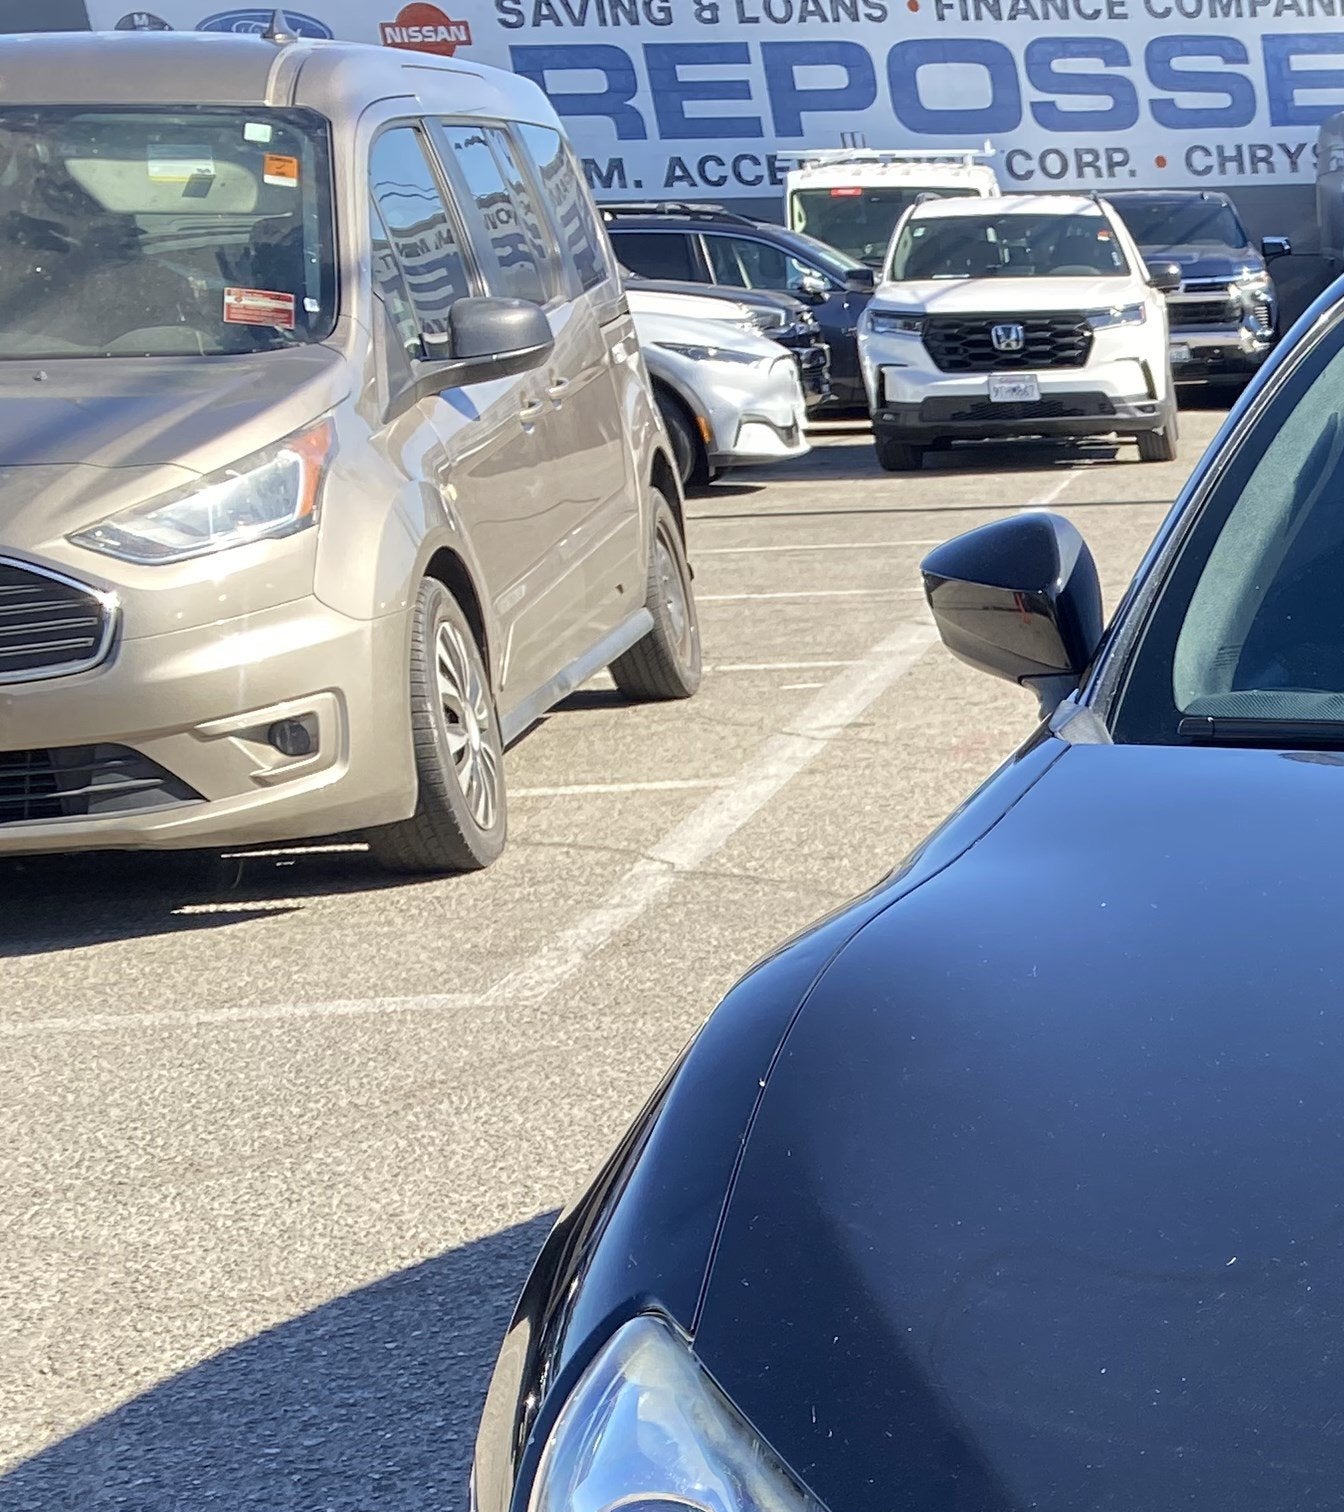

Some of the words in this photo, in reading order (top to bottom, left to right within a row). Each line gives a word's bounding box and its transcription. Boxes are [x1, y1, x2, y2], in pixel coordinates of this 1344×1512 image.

[498, 0, 674, 29] SAVING
[737, 0, 889, 25] LOANS
[384, 25, 467, 44] NISSAN
[1005, 147, 1137, 181] CORP.
